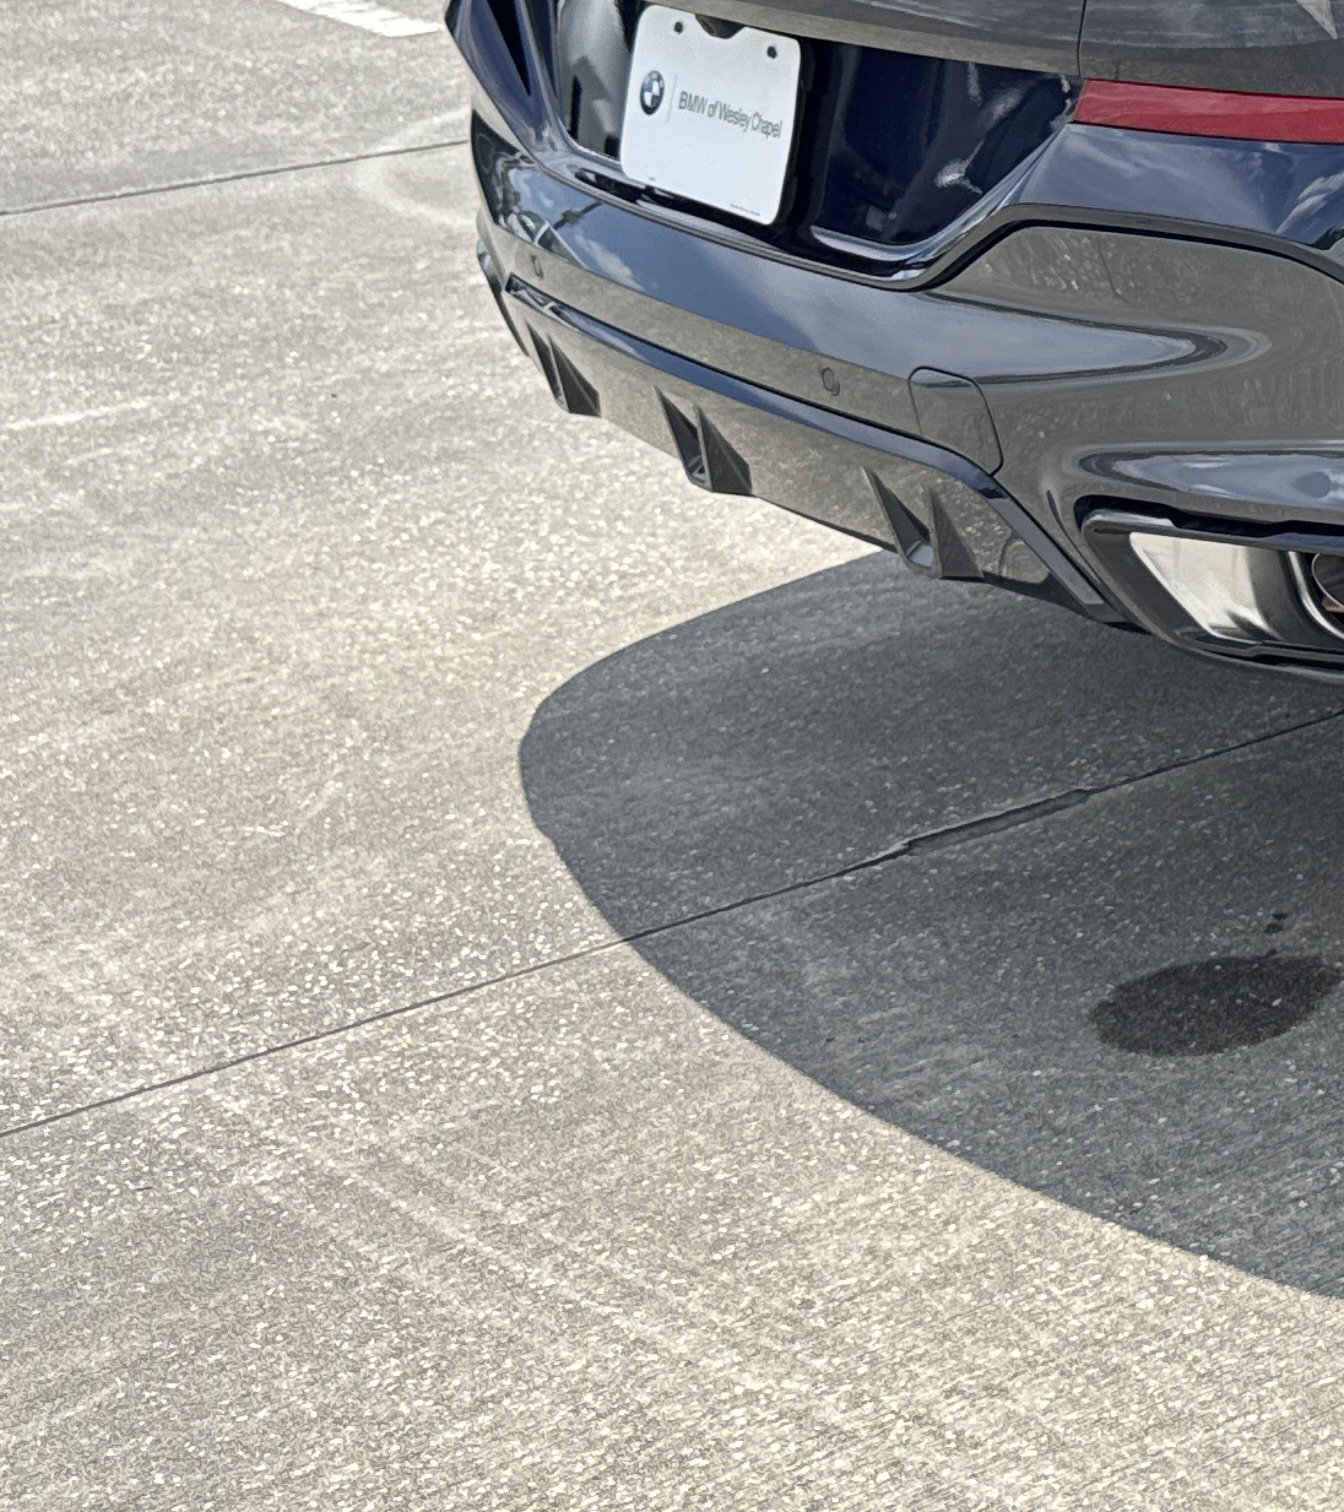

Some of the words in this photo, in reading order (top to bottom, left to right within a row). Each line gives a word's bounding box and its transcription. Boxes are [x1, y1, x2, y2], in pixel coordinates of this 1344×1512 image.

[679, 91, 708, 115] BMW
[707, 100, 721, 118] of
[718, 102, 751, 133] Wesley
[751, 111, 782, 139] Chapel
